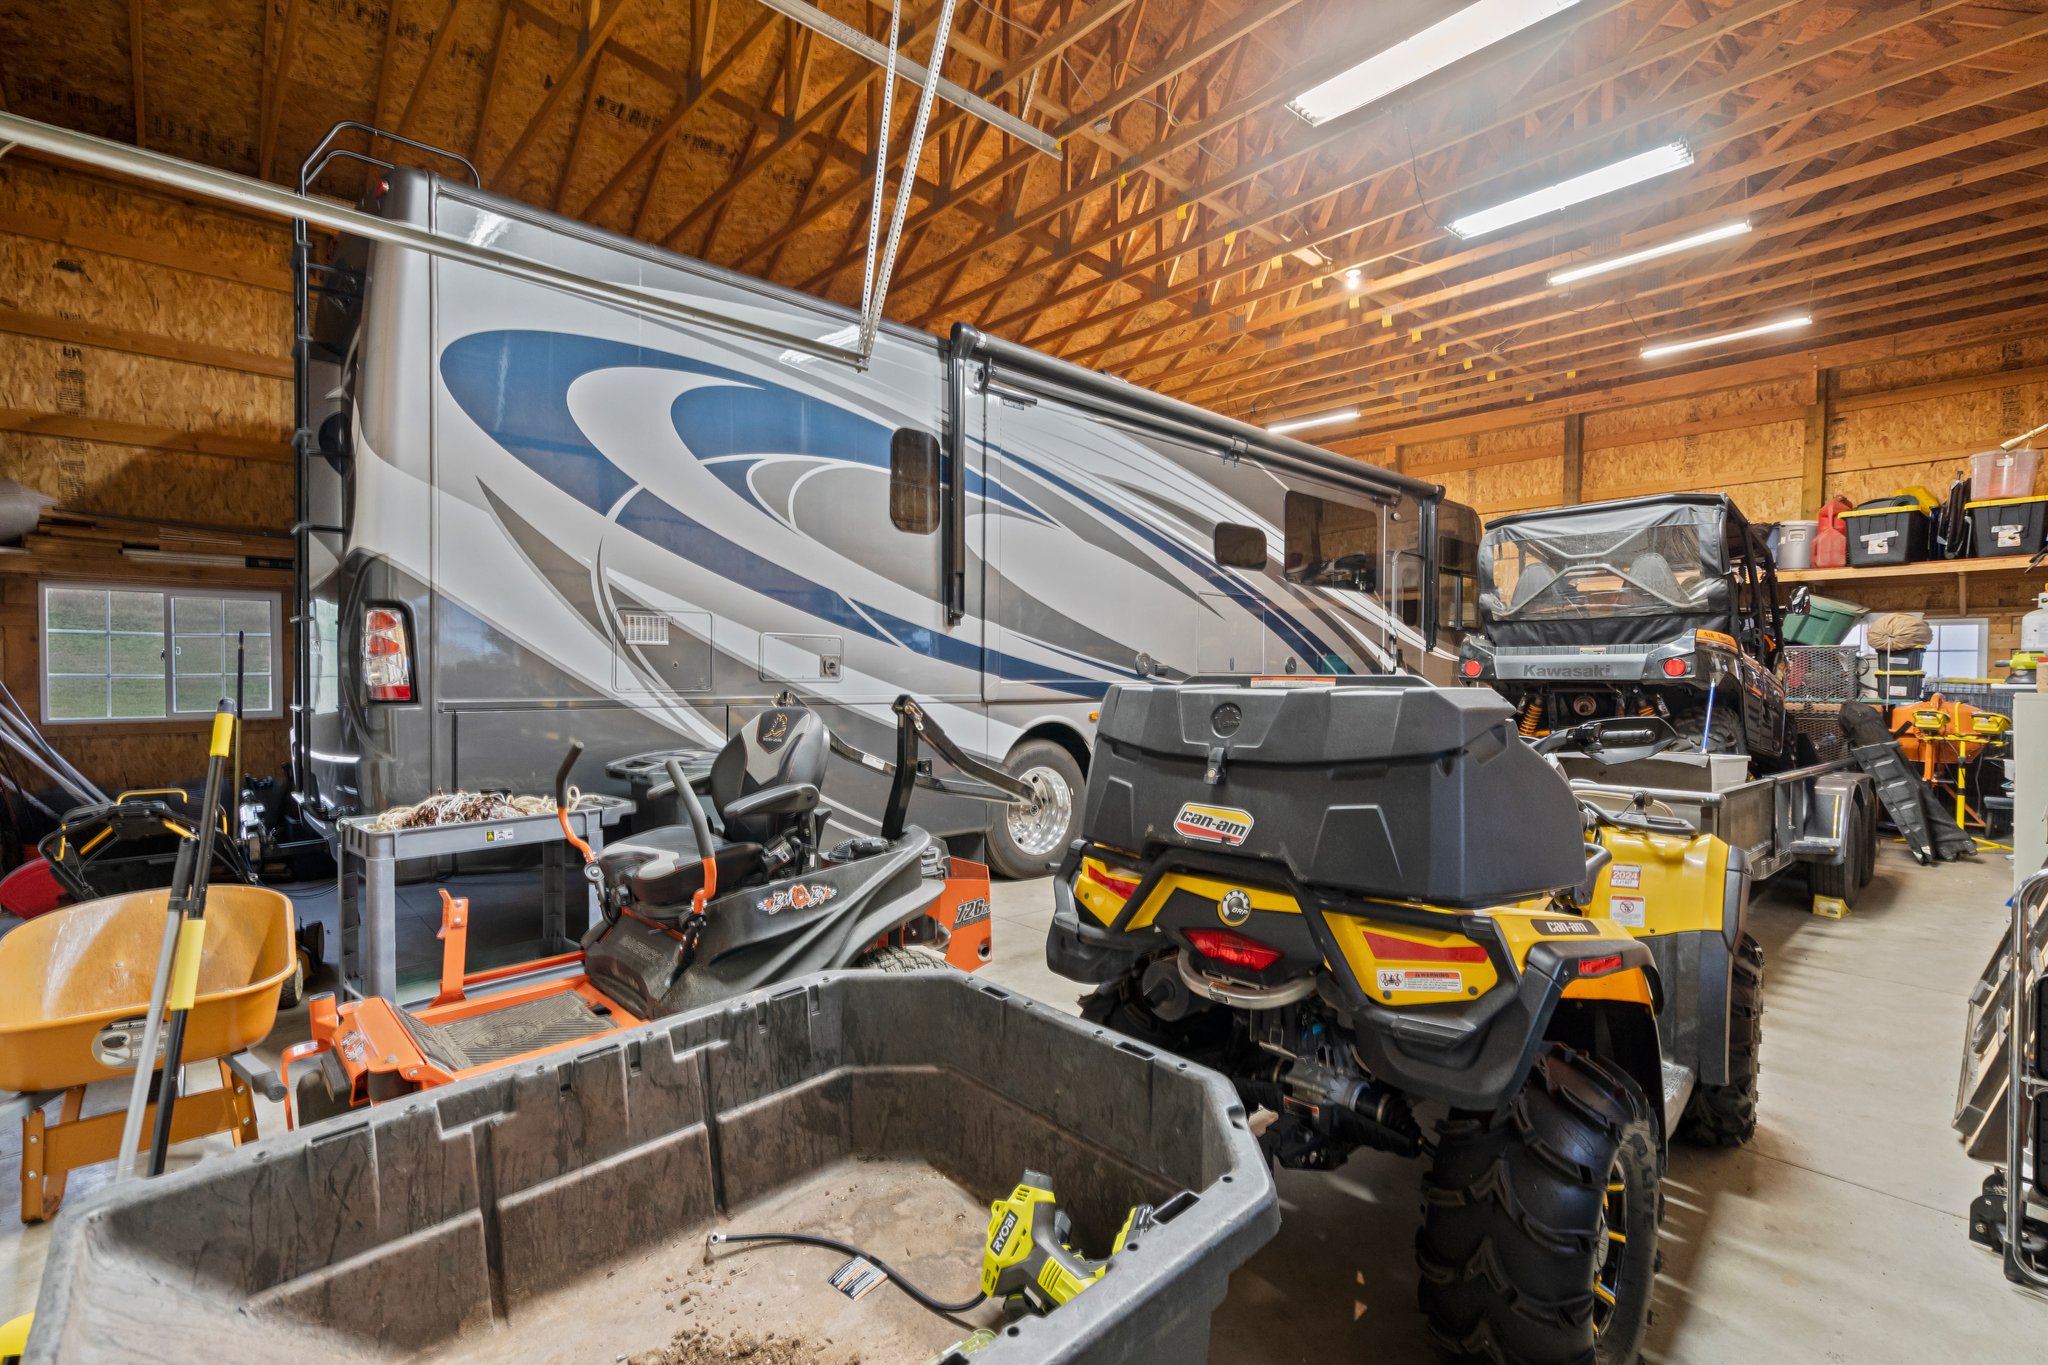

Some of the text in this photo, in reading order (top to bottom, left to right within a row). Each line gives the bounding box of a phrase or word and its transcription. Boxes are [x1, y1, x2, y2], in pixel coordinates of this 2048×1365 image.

[1523, 664, 1611, 677] Kawasaki
[1180, 811, 1247, 837] can-am
[1612, 871, 1639, 881] 2024
[1231, 906, 1249, 916] BRP
[1545, 921, 1589, 933] can-am
[992, 1213, 1016, 1252] RYOBI
